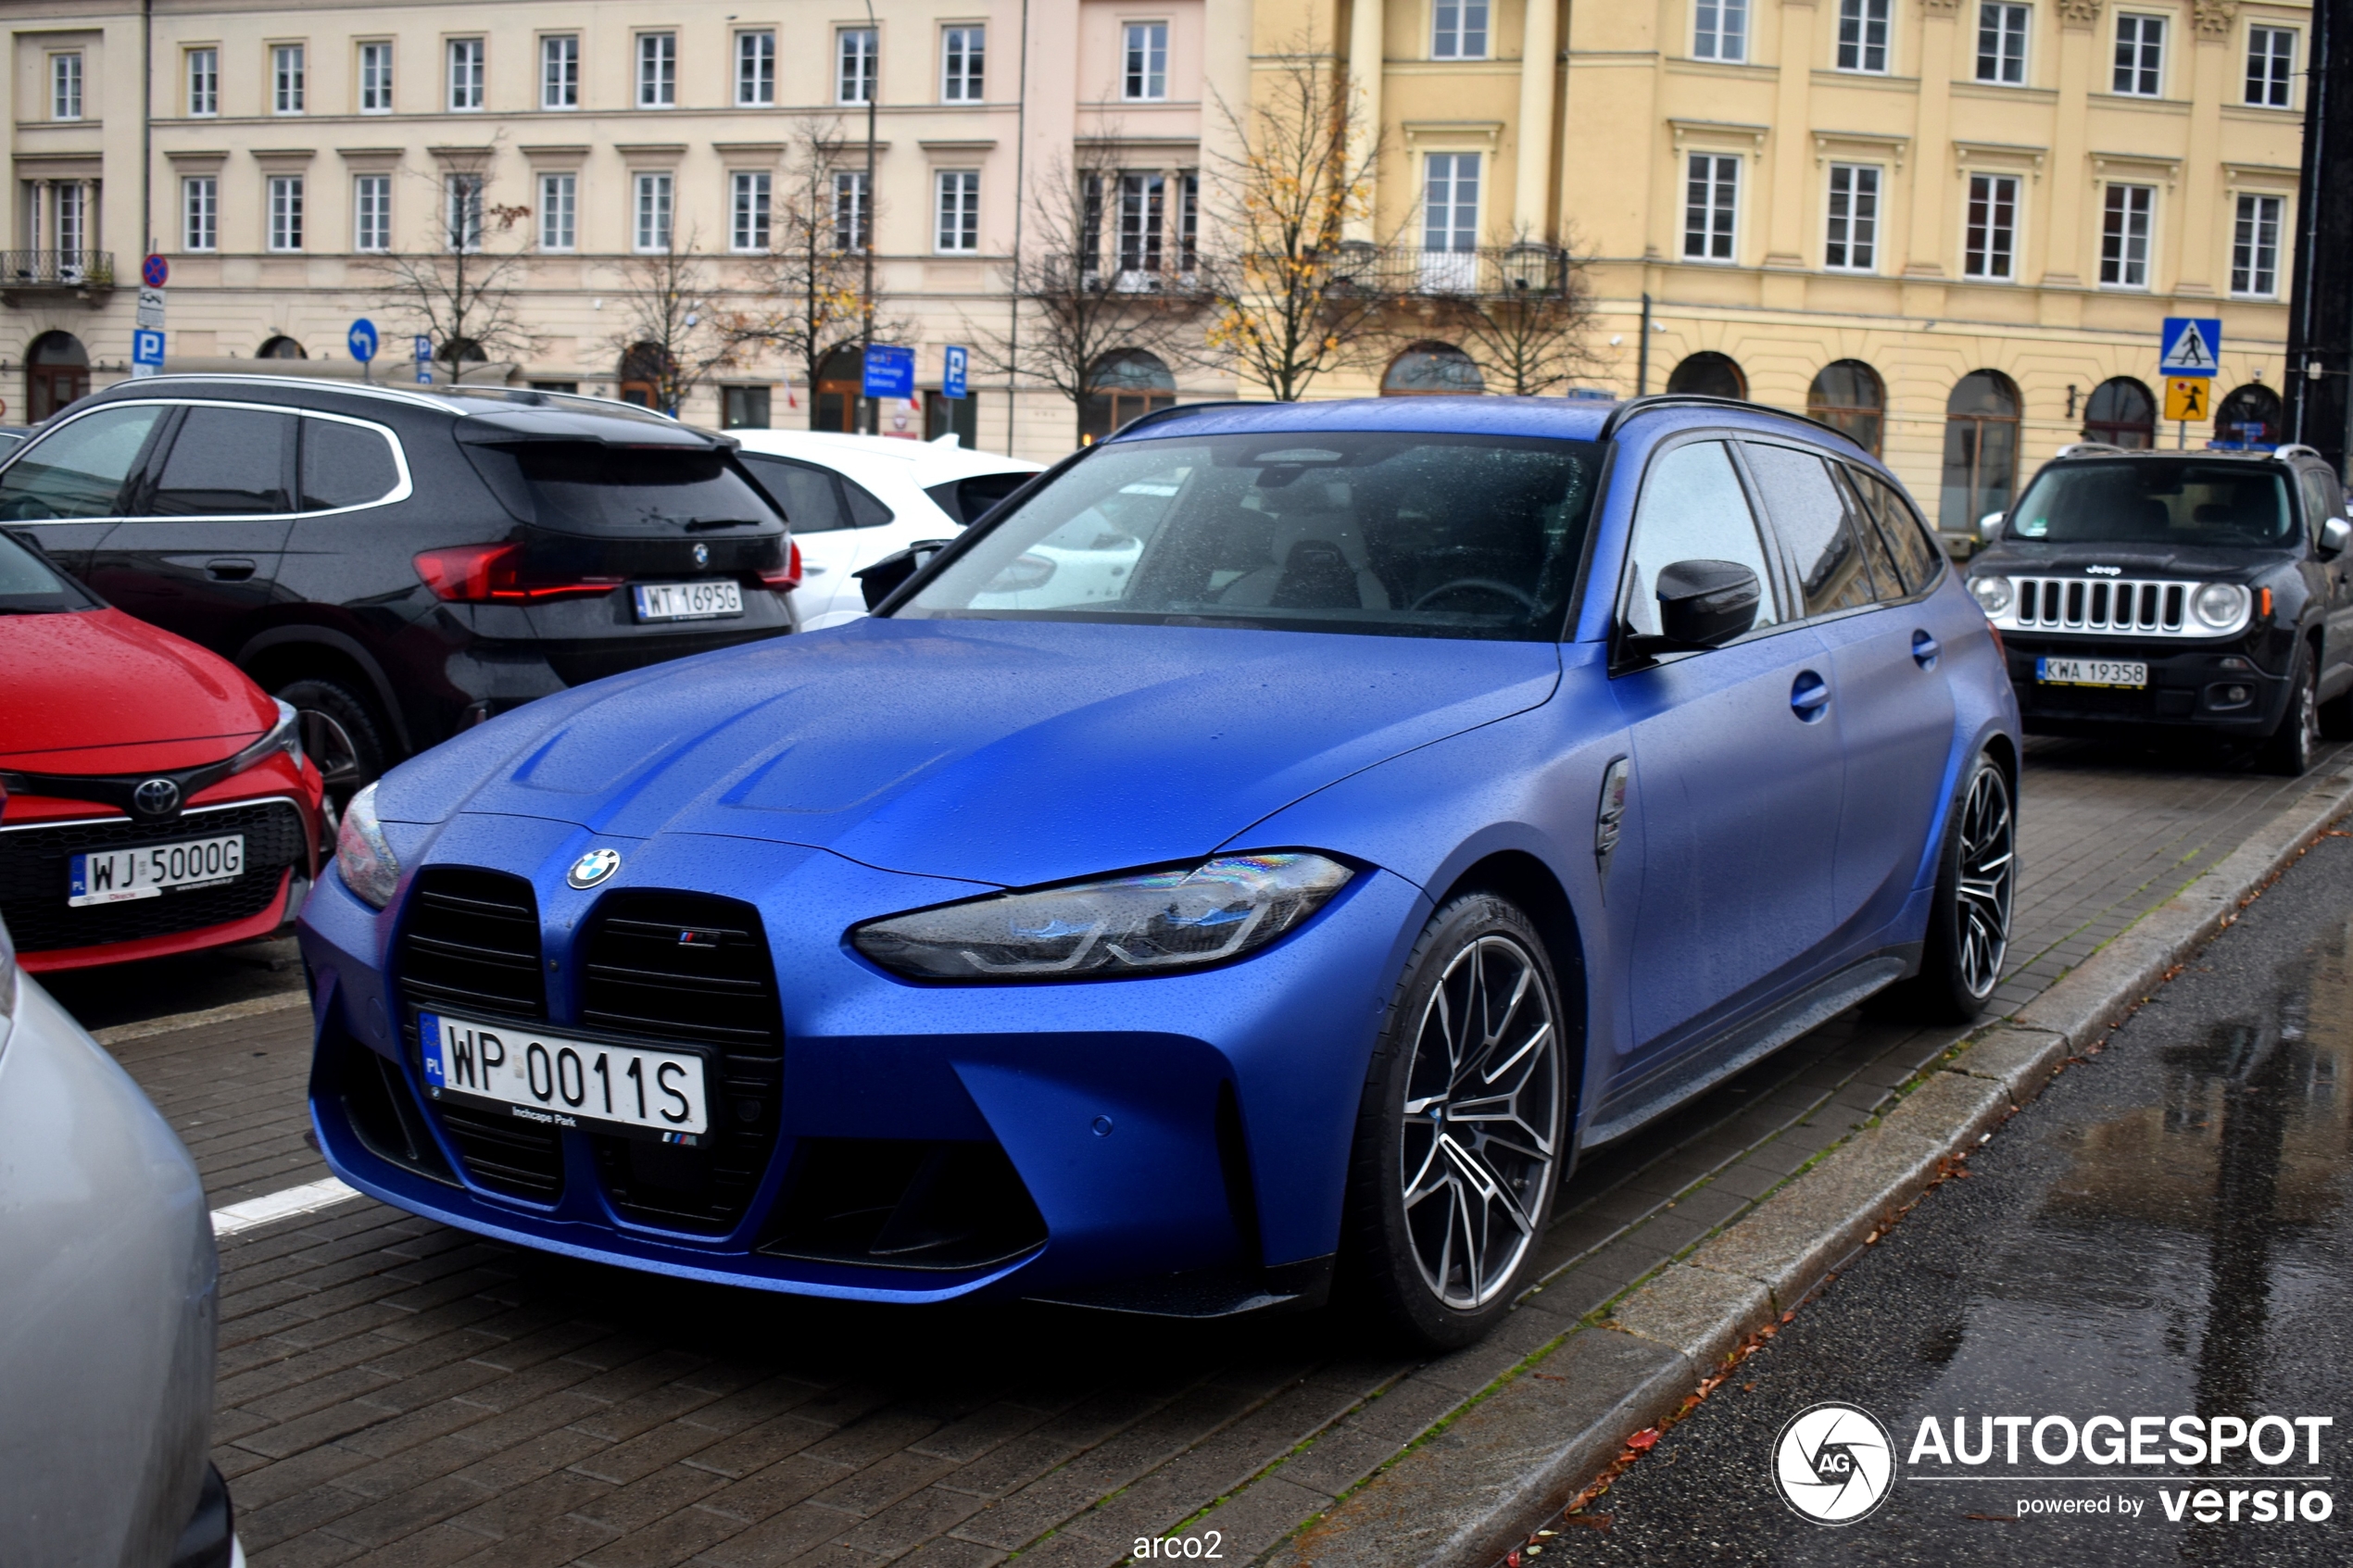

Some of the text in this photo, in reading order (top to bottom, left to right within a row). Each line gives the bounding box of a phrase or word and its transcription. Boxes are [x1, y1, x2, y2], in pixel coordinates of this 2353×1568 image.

[140, 333, 159, 360] P
[949, 350, 964, 383] P
[2085, 564, 2121, 576] Jeep
[648, 584, 737, 613] WT 1695G
[2046, 660, 2144, 683] KWA 19358
[94, 839, 239, 891] WJ 5000G
[72, 881, 85, 891] PL
[426, 1058, 443, 1075] PL
[448, 1025, 689, 1124] WP 0011S
[554, 1113, 577, 1128] Park
